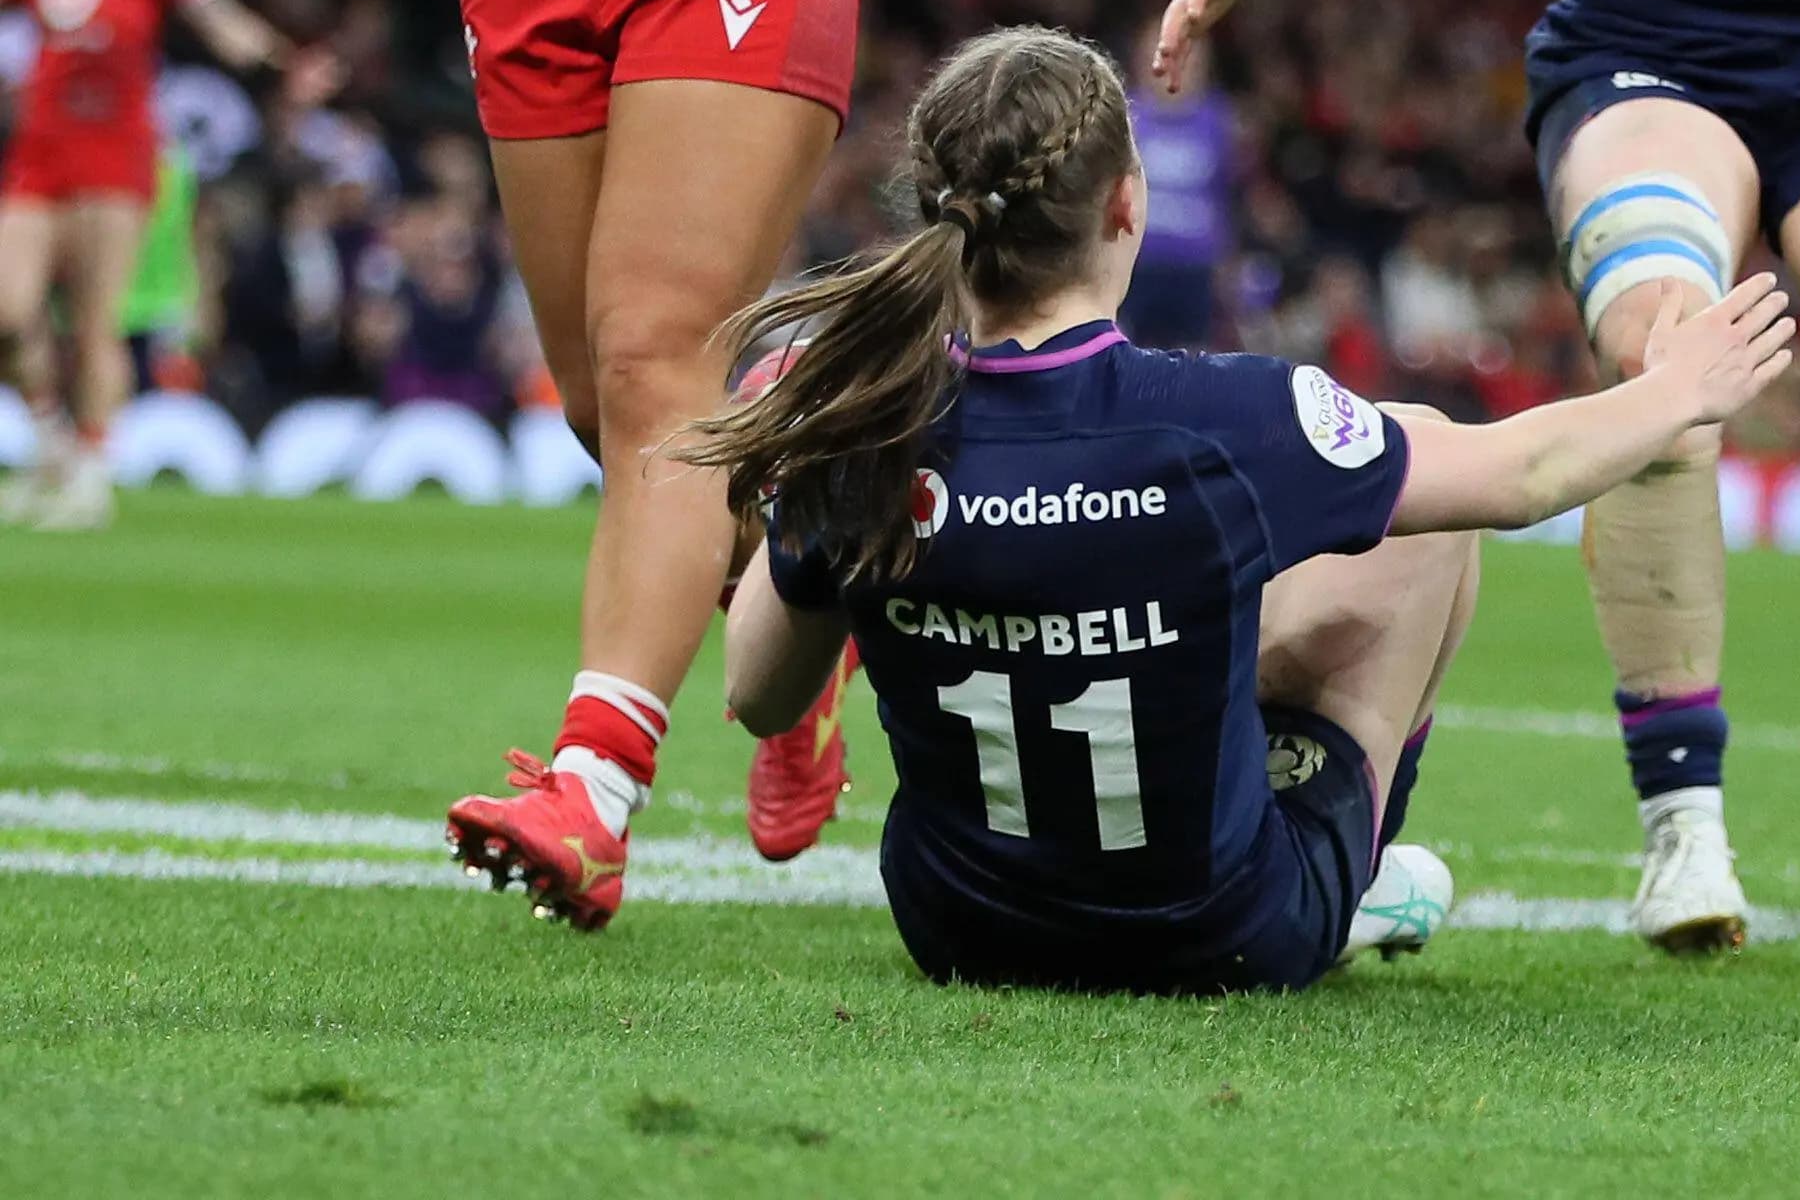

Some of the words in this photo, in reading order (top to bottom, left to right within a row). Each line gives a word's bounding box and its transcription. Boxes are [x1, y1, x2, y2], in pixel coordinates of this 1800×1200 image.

[957, 482, 1167, 527] vodafone
[885, 598, 1179, 657] CAMPBELL
[937, 670, 1147, 851] 11
